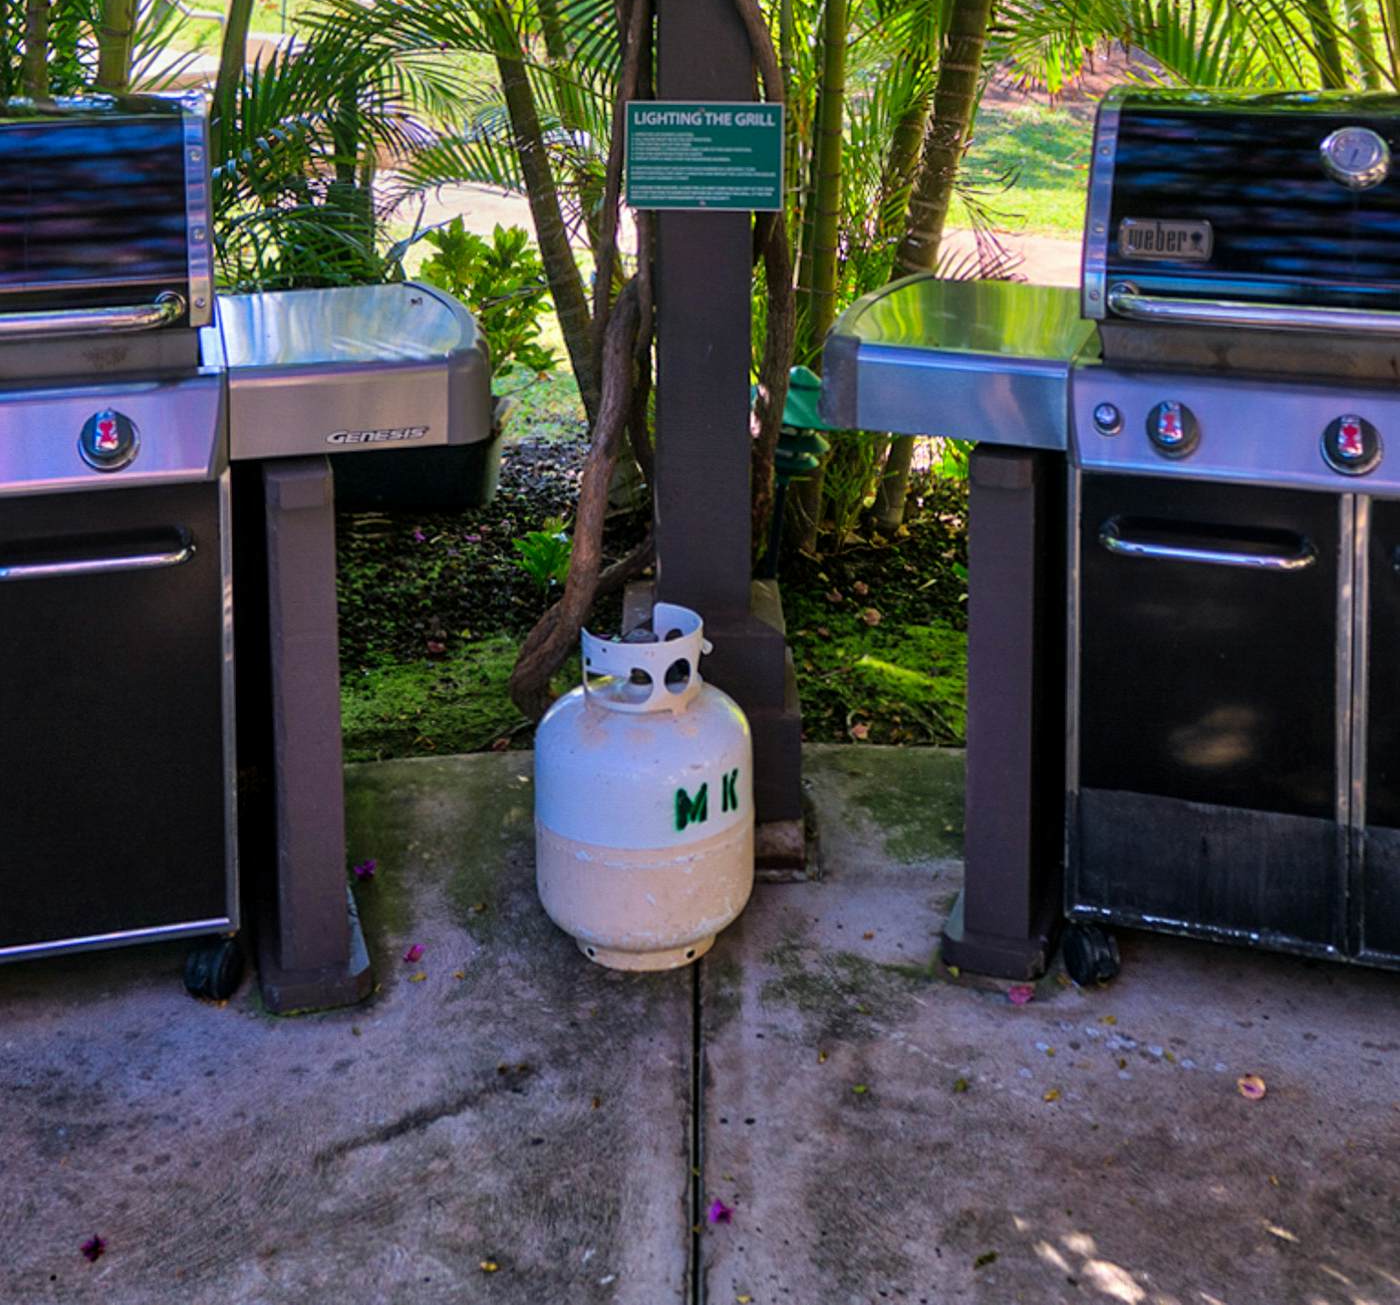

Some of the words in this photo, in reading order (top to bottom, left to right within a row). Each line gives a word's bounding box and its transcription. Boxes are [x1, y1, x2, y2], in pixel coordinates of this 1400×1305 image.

[633, 111, 702, 126] LIGHTING
[704, 112, 732, 126] THE
[735, 112, 775, 127] GRILL
[1127, 220, 1187, 253] weber
